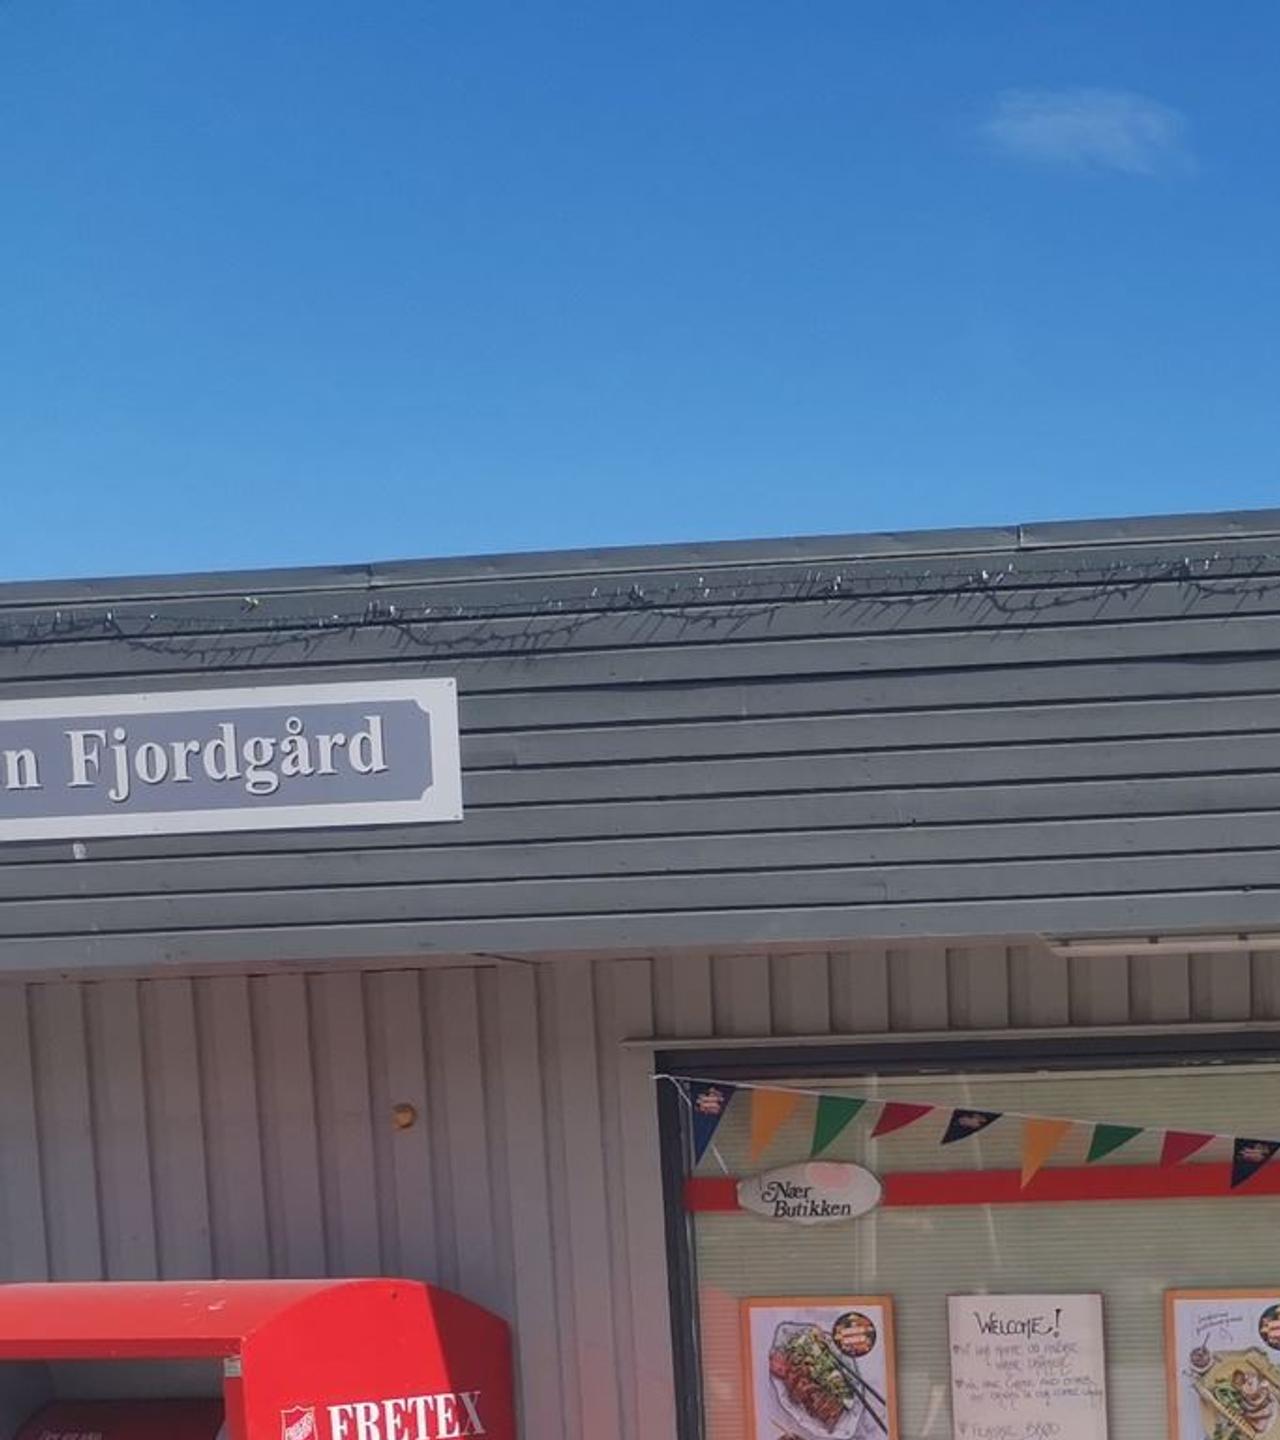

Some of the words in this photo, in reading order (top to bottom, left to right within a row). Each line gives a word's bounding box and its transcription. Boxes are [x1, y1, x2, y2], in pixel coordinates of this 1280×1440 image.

[65, 716, 388, 801] Fjordgård
[761, 1181, 811, 1202] Nær
[774, 1200, 851, 1217] Butikken
